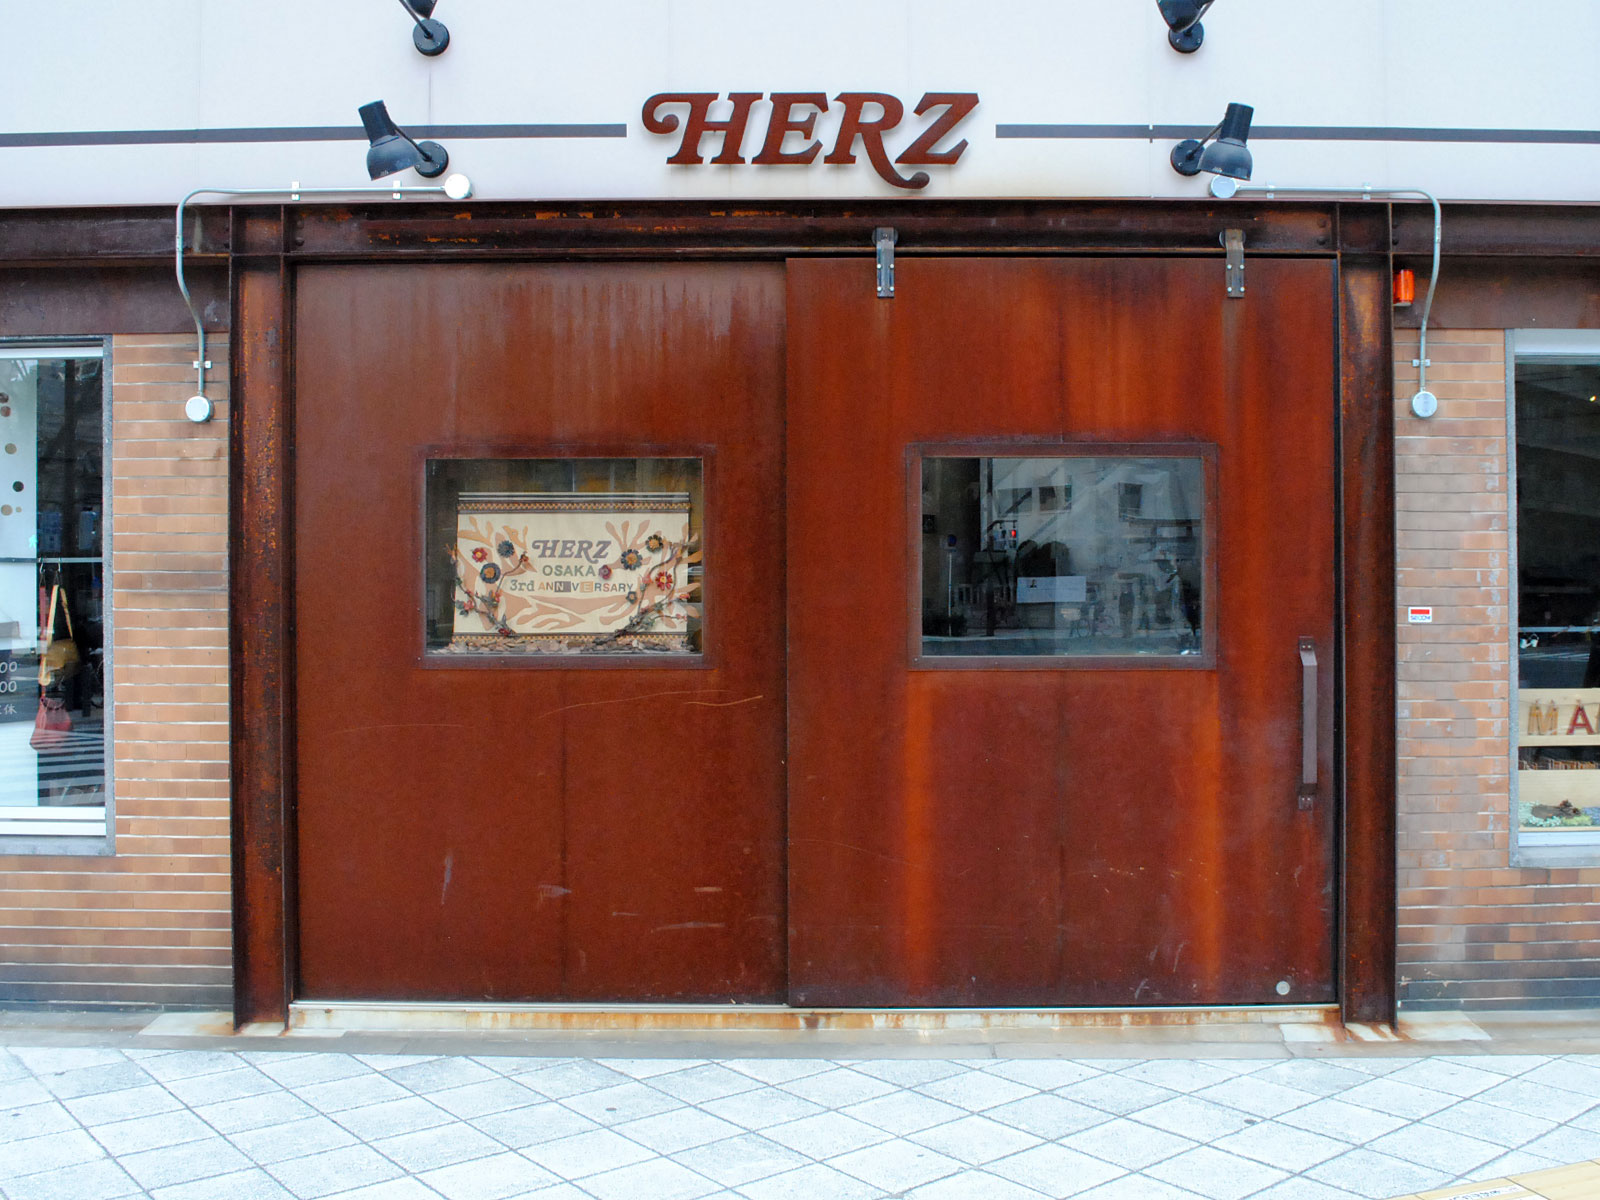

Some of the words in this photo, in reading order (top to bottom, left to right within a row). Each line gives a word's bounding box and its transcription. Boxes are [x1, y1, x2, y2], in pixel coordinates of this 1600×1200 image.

[642, 92, 980, 190] HERZ
[532, 540, 611, 564] HERZ
[542, 565, 596, 577] OSAKA
[510, 580, 534, 592] 3rd
[538, 581, 634, 592] ANNVERSARY
[0, 703, 17, 715] 休
[1527, 704, 1600, 735] MA
